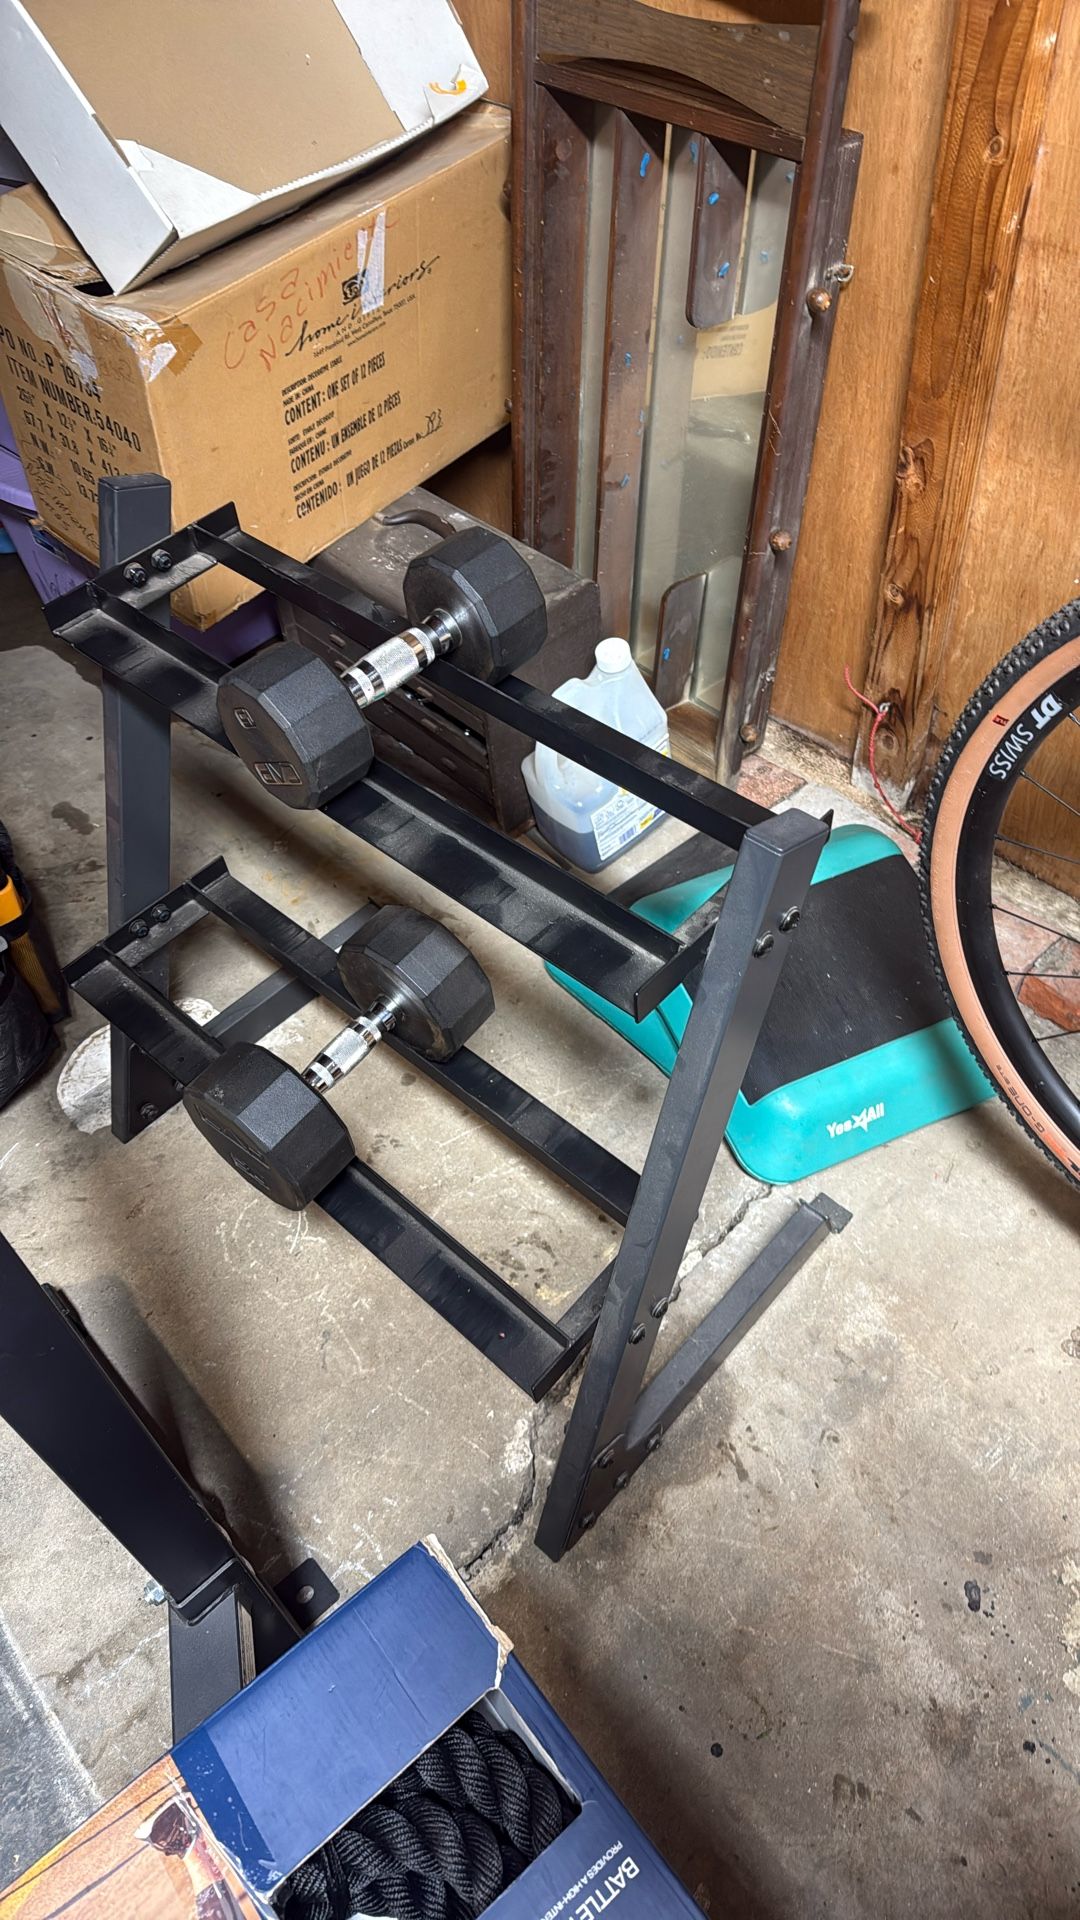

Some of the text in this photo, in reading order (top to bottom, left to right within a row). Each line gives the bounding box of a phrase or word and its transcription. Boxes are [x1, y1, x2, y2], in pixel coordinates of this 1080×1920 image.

[7, 355, 37, 389] ITEM
[327, 380, 339, 400] ONE
[340, 373, 350, 392] SET
[351, 367, 358, 385] OF
[360, 363, 367, 379] 12
[368, 351, 385, 375] PIECES
[43, 401, 53, 419] X
[84, 427, 93, 444] X
[331, 432, 340, 449] UN
[341, 413, 367, 443] ENSEMBLE
[368, 409, 376, 425] DE
[377, 404, 383, 418] 12
[384, 390, 401, 414] PIÈCES
[47, 424, 57, 441] X
[87, 448, 96, 466] X
[346, 471, 354, 487] UN
[355, 459, 371, 485] JUEGO
[372, 453, 379, 470] DE
[380, 452, 386, 465] 12
[386, 439, 402, 460] PIEZAS
[1030, 693, 1063, 730] DT
[989, 723, 1034, 780] SWISS
[579, 1874, 589, 1885] A
[586, 1840, 623, 1880] PROVIDES
[575, 1856, 640, 1920] BATTLE
